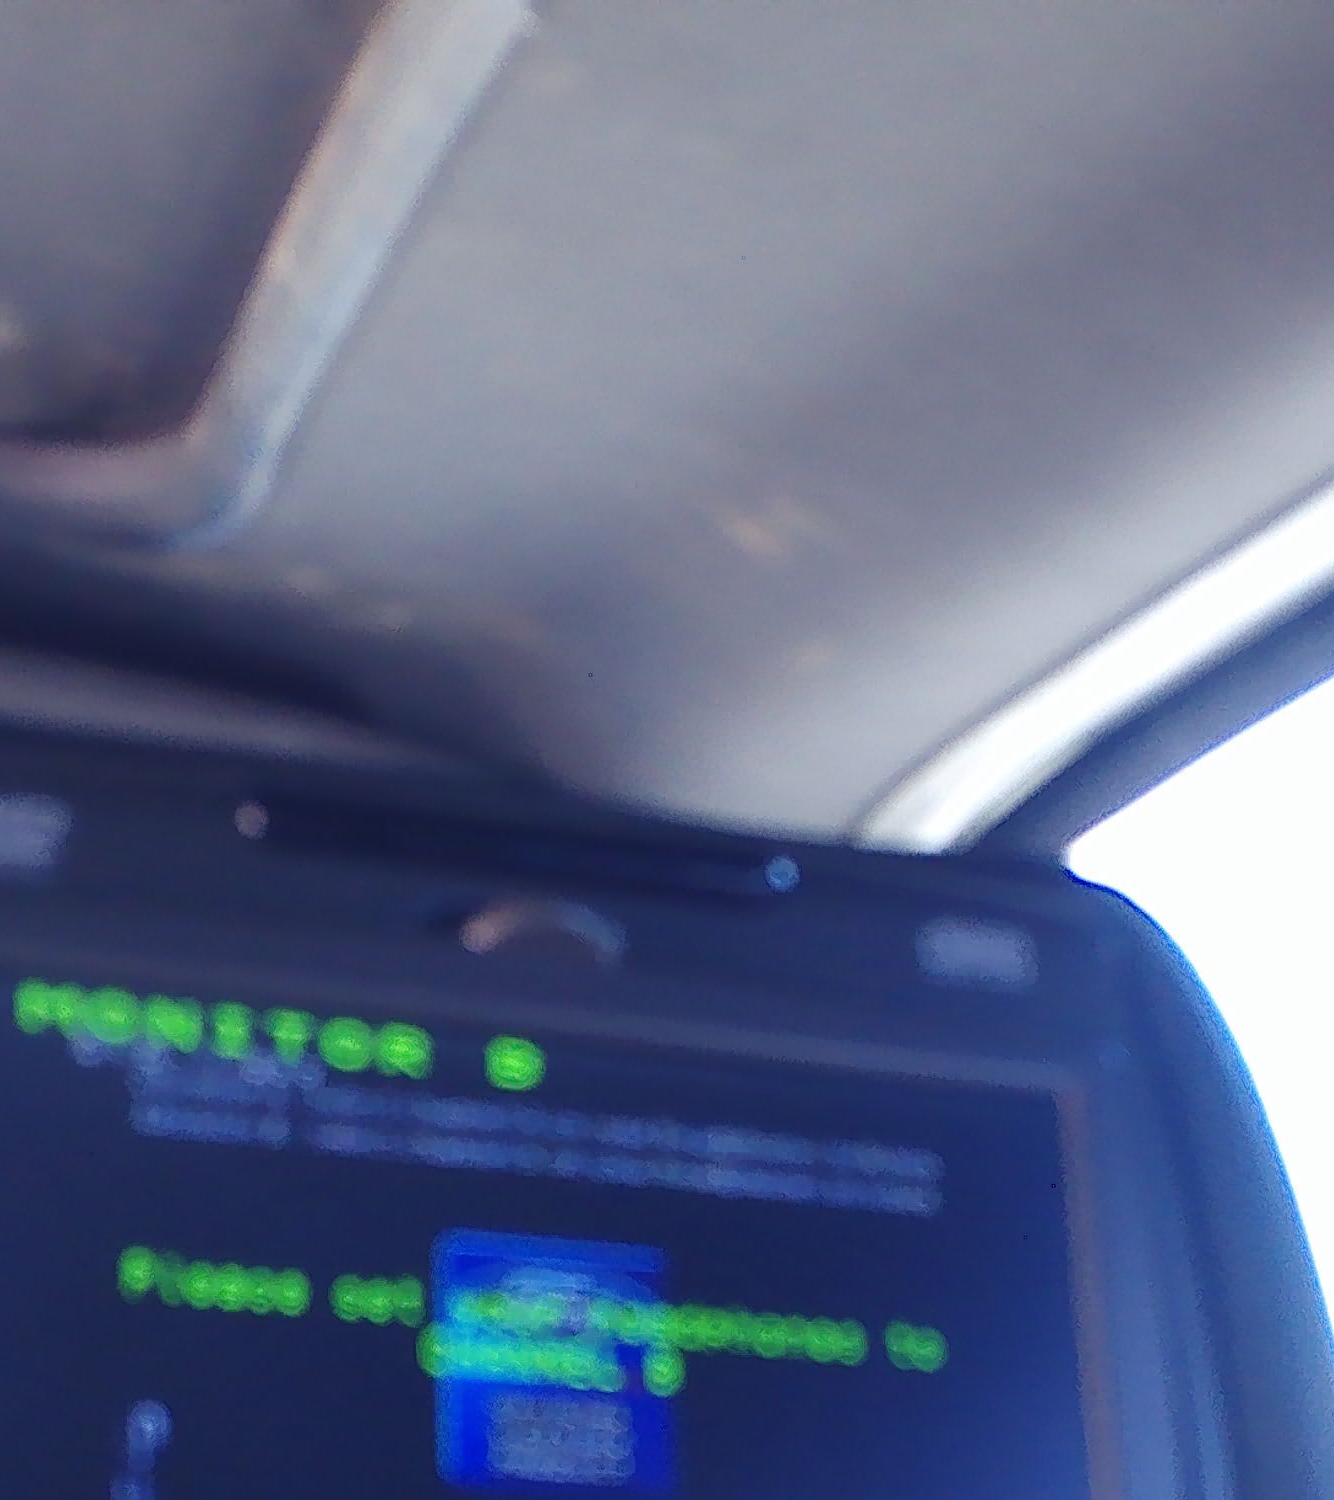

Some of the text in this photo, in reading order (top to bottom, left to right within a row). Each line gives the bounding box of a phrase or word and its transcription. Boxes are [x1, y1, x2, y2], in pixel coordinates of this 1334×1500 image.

[13, 976, 434, 1079] MONITOR
[117, 1246, 312, 1317] Please
[330, 1274, 426, 1326] set
[886, 1322, 947, 1373] to
